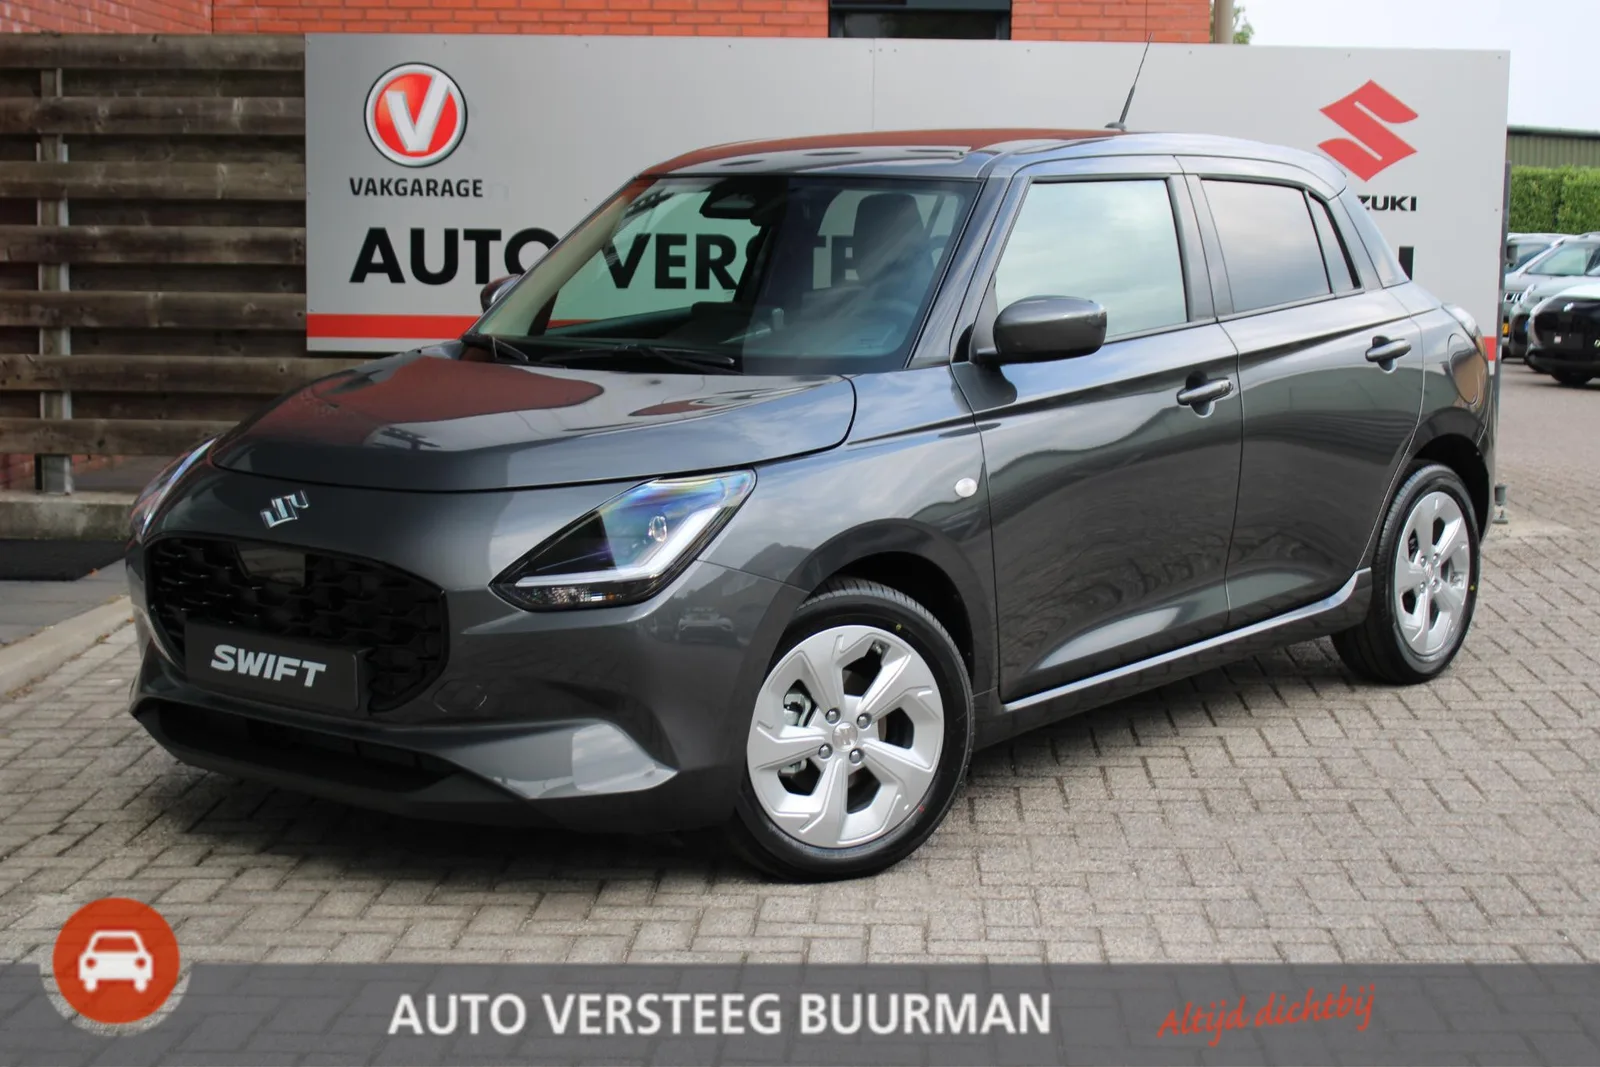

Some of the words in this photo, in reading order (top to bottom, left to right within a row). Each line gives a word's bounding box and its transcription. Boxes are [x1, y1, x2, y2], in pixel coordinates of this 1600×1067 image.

[349, 177, 483, 198] VAKGARAGE
[1357, 194, 1417, 211] ZUKI
[210, 644, 327, 688] SWIFT
